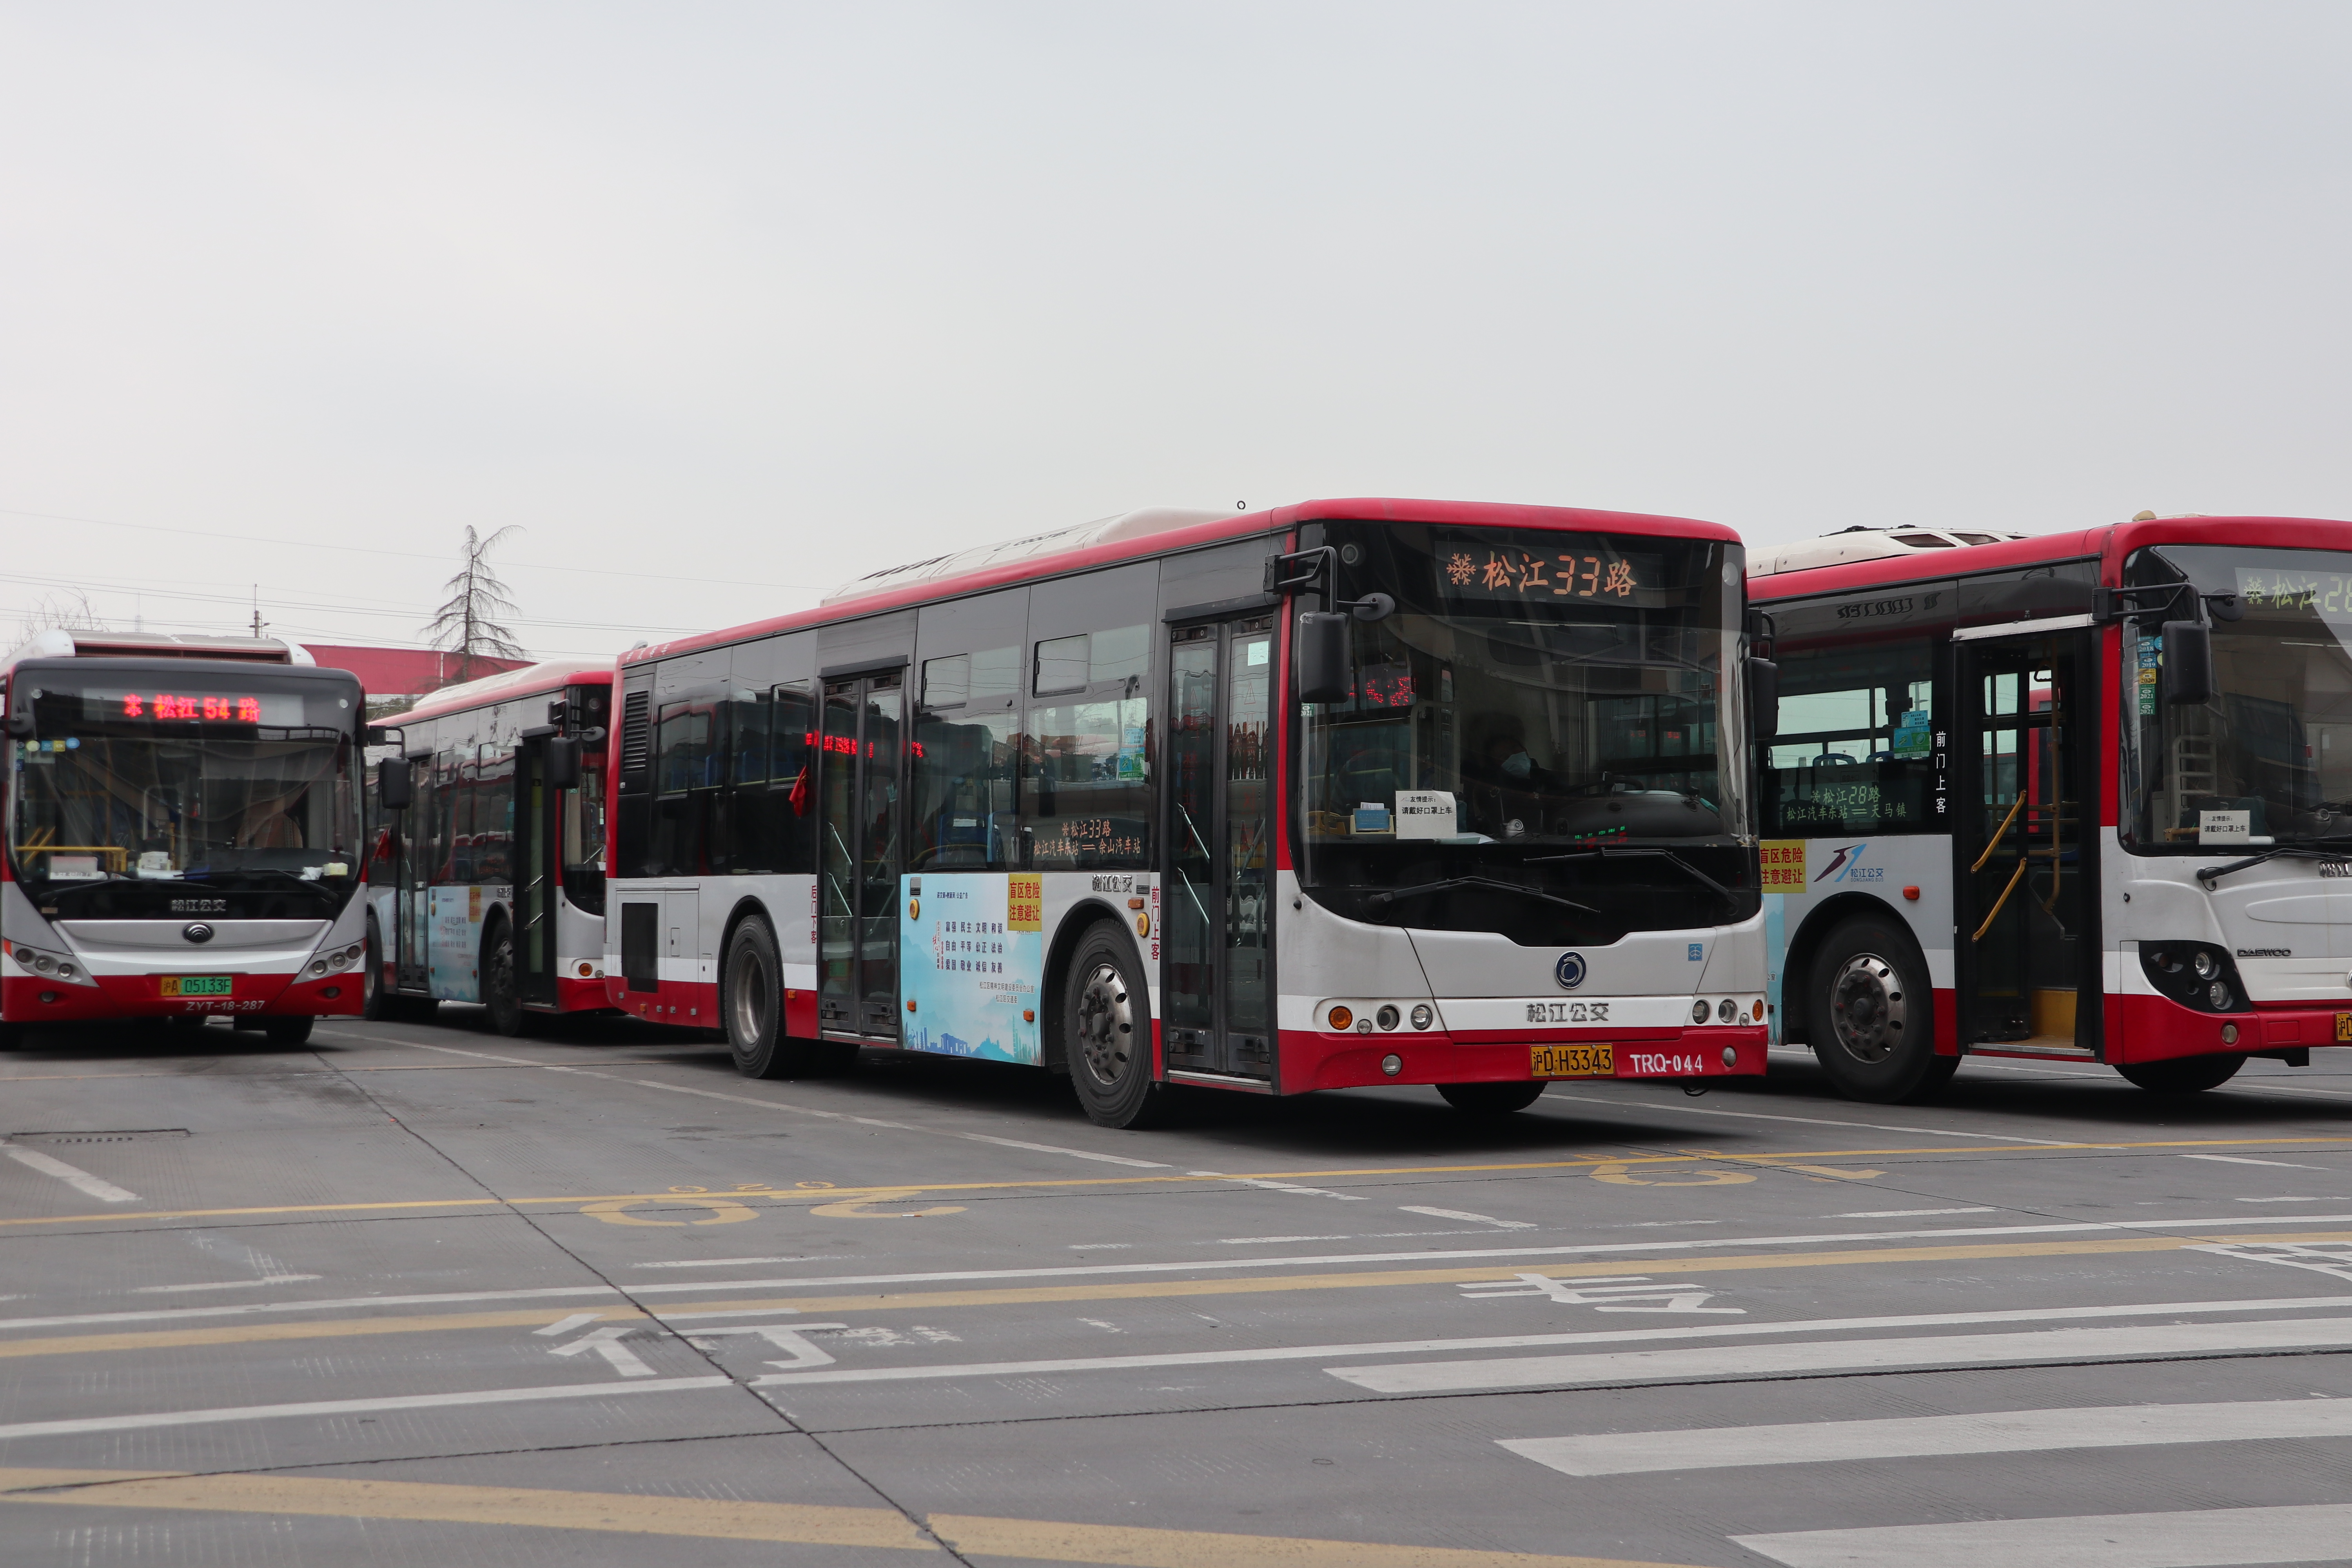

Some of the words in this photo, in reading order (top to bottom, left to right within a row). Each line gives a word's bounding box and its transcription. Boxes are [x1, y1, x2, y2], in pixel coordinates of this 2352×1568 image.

[1482, 551, 1636, 597] 松江33路
[1936, 731, 1945, 813] 前门上客
[1823, 785, 1881, 804] 松江28路
[1786, 804, 1848, 821] 松江汽车东站
[1871, 802, 1907, 818] 天马镇
[1071, 819, 1111, 838] 松江33路
[1034, 838, 1079, 857] 松江汽车东站
[1760, 847, 1803, 864] 盲区危险
[1851, 868, 1884, 877] 松江公交
[1010, 882, 1040, 899] 盲区危险
[1092, 874, 1132, 893] 松江公交
[172, 899, 226, 911] 松江公交
[1009, 904, 1040, 921] 注意避让
[946, 921, 956, 933] 富强
[960, 922, 972, 933] 民主
[976, 922, 987, 934] 文明
[991, 922, 1003, 934] 和谐
[1151, 886, 1160, 960] 前门上客
[946, 940, 956, 952] 自由
[960, 941, 971, 953] 平等
[976, 942, 987, 953] 公正
[991, 942, 1003, 954] 法治
[2238, 948, 2291, 956] DAEWOO
[946, 959, 956, 971] 爱国
[960, 960, 972, 971] 敬业
[976, 960, 987, 973] 诚信
[991, 961, 1003, 974] 友善
[186, 1000, 265, 1011] ZYT-18-287
[1526, 1003, 1609, 1022] 松江公交
[1630, 1053, 1703, 1073] TRQ-044
